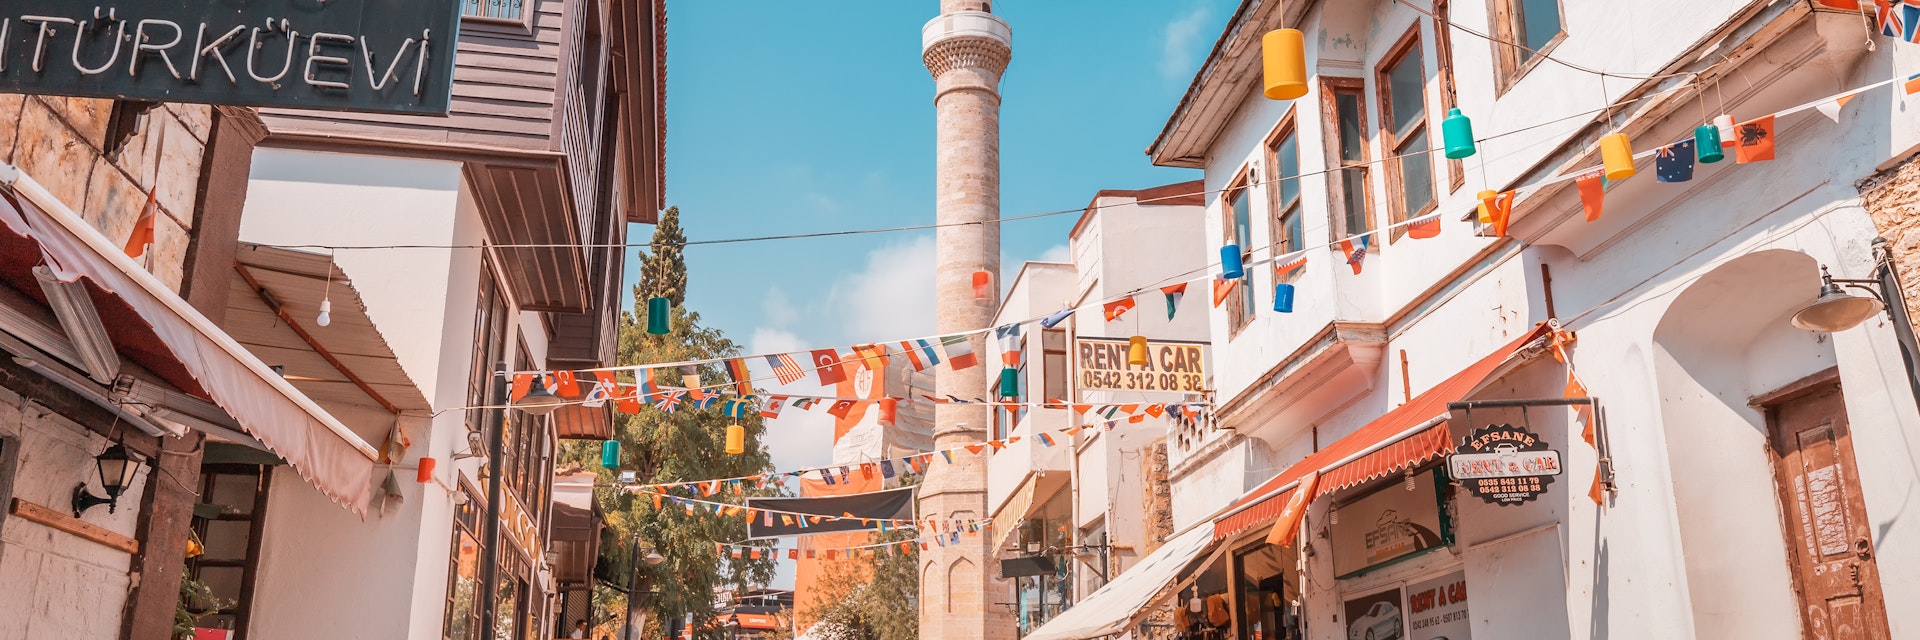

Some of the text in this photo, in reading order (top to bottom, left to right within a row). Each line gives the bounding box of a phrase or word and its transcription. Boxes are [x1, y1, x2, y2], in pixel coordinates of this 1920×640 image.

[1080, 342, 1131, 371] RENT
[1160, 345, 1202, 373] CAR
[1083, 370, 1202, 392] 0542 312 08 38
[1470, 431, 1535, 451] EFSANE
[1455, 458, 1504, 475] RENT
[1523, 456, 1557, 472] CAR
[1478, 477, 1540, 487] 0535 843 11 79
[1480, 484, 1541, 494] 0542 312 08 38
[1410, 588, 1435, 614] RENT
[1438, 586, 1447, 607] A
